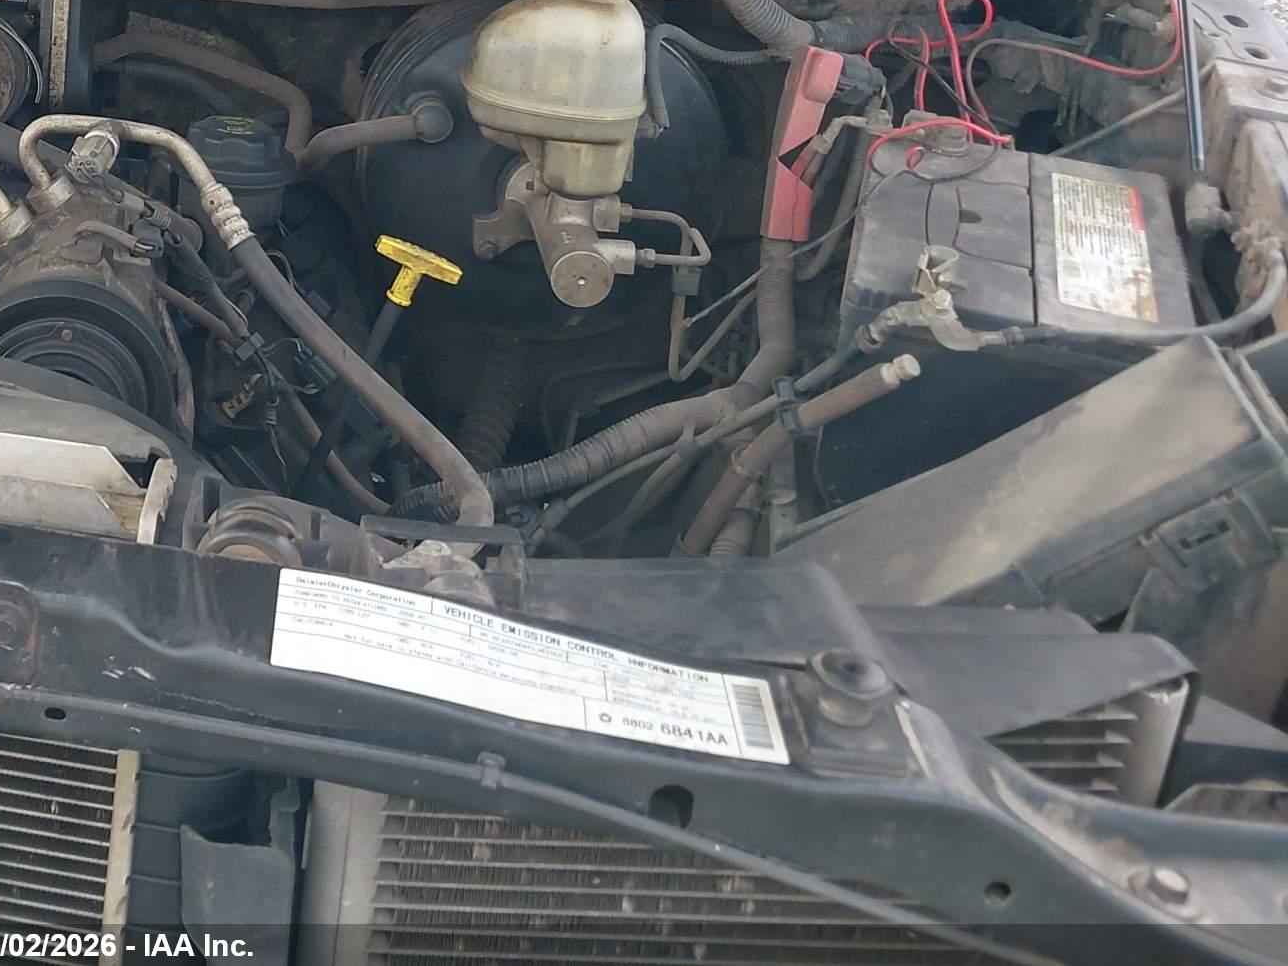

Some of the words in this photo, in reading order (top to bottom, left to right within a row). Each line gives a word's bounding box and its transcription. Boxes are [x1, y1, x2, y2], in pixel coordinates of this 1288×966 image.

[367, 589, 417, 606] Corporation
[444, 604, 495, 629] VEHICLE
[500, 622, 562, 647] EMISSION
[567, 639, 619, 661] CONTROL
[626, 656, 710, 683] INFORMATION
[661, 721, 729, 746] 6841AA
